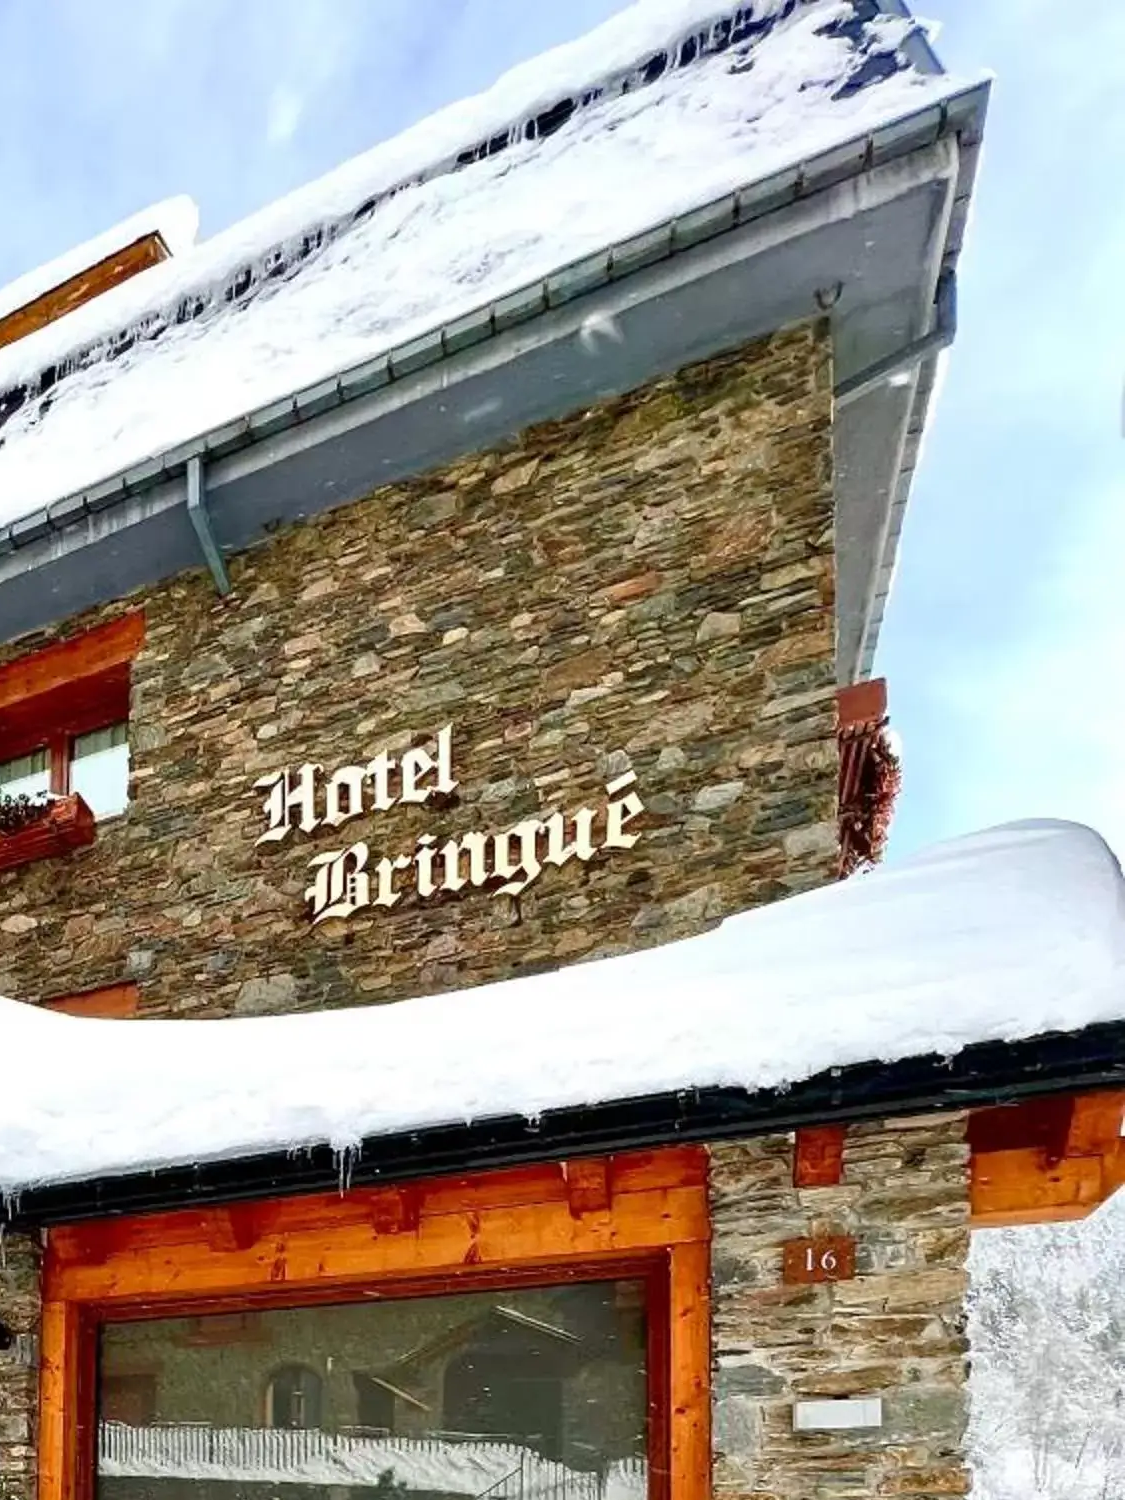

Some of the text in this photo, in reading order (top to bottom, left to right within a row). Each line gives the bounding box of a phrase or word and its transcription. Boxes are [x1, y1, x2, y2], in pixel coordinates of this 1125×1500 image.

[253, 722, 459, 846] Hotel
[304, 769, 646, 925] Bringué
[805, 1248, 837, 1271] 16
